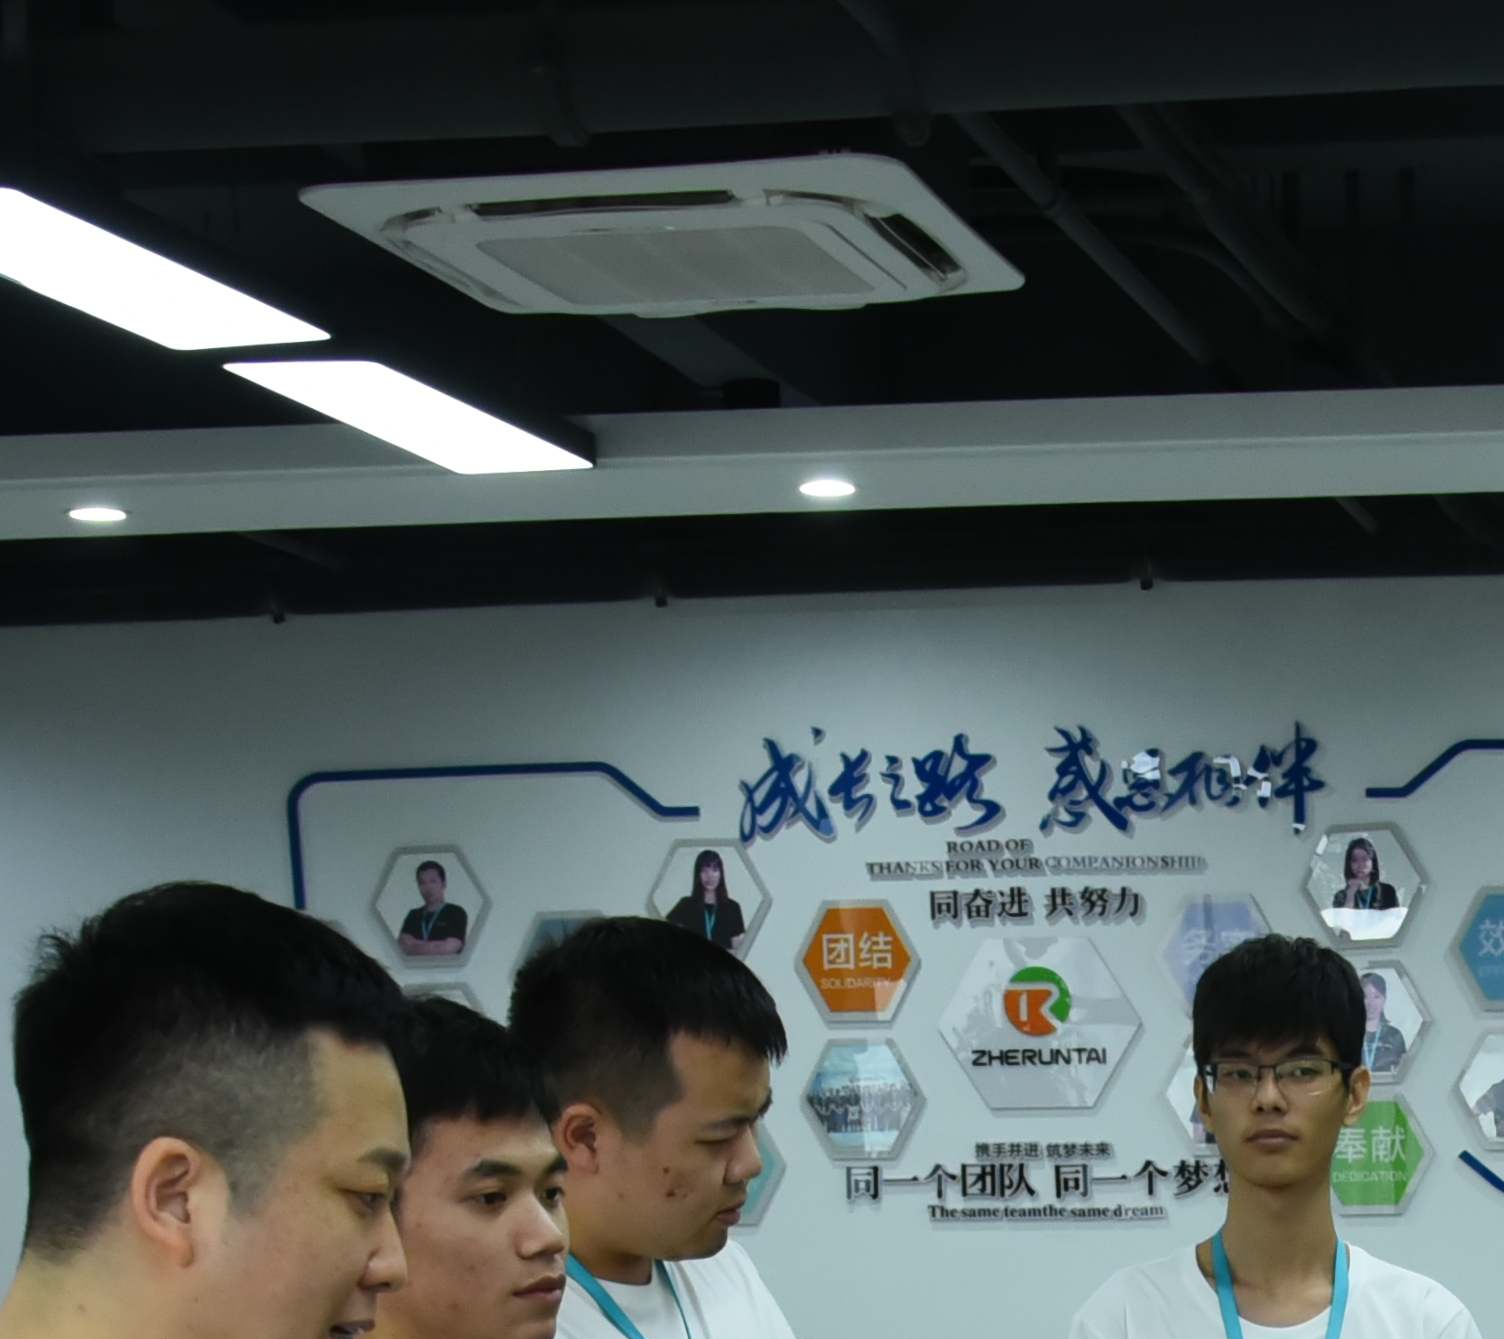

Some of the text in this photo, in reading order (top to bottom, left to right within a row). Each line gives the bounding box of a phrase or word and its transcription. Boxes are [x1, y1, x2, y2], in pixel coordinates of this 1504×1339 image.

[946, 838, 1030, 855] ROAD OF
[866, 855, 1205, 876] THANKS FOR YOUR COMPANIONSHIP
[929, 886, 1141, 920] 同奋进 共努力
[822, 932, 893, 970] 团结
[971, 1047, 1107, 1067] ZHERUNTAI
[1047, 1142, 1111, 1158] 筑梦未来
[1334, 1124, 1406, 1164] 奉献
[845, 1163, 1036, 1200] 同一个团队
[929, 1205, 958, 1218] The
[960, 1208, 1000, 1218] same
[1070, 1208, 1111, 1218] same
[1113, 1204, 1165, 1217] dream
